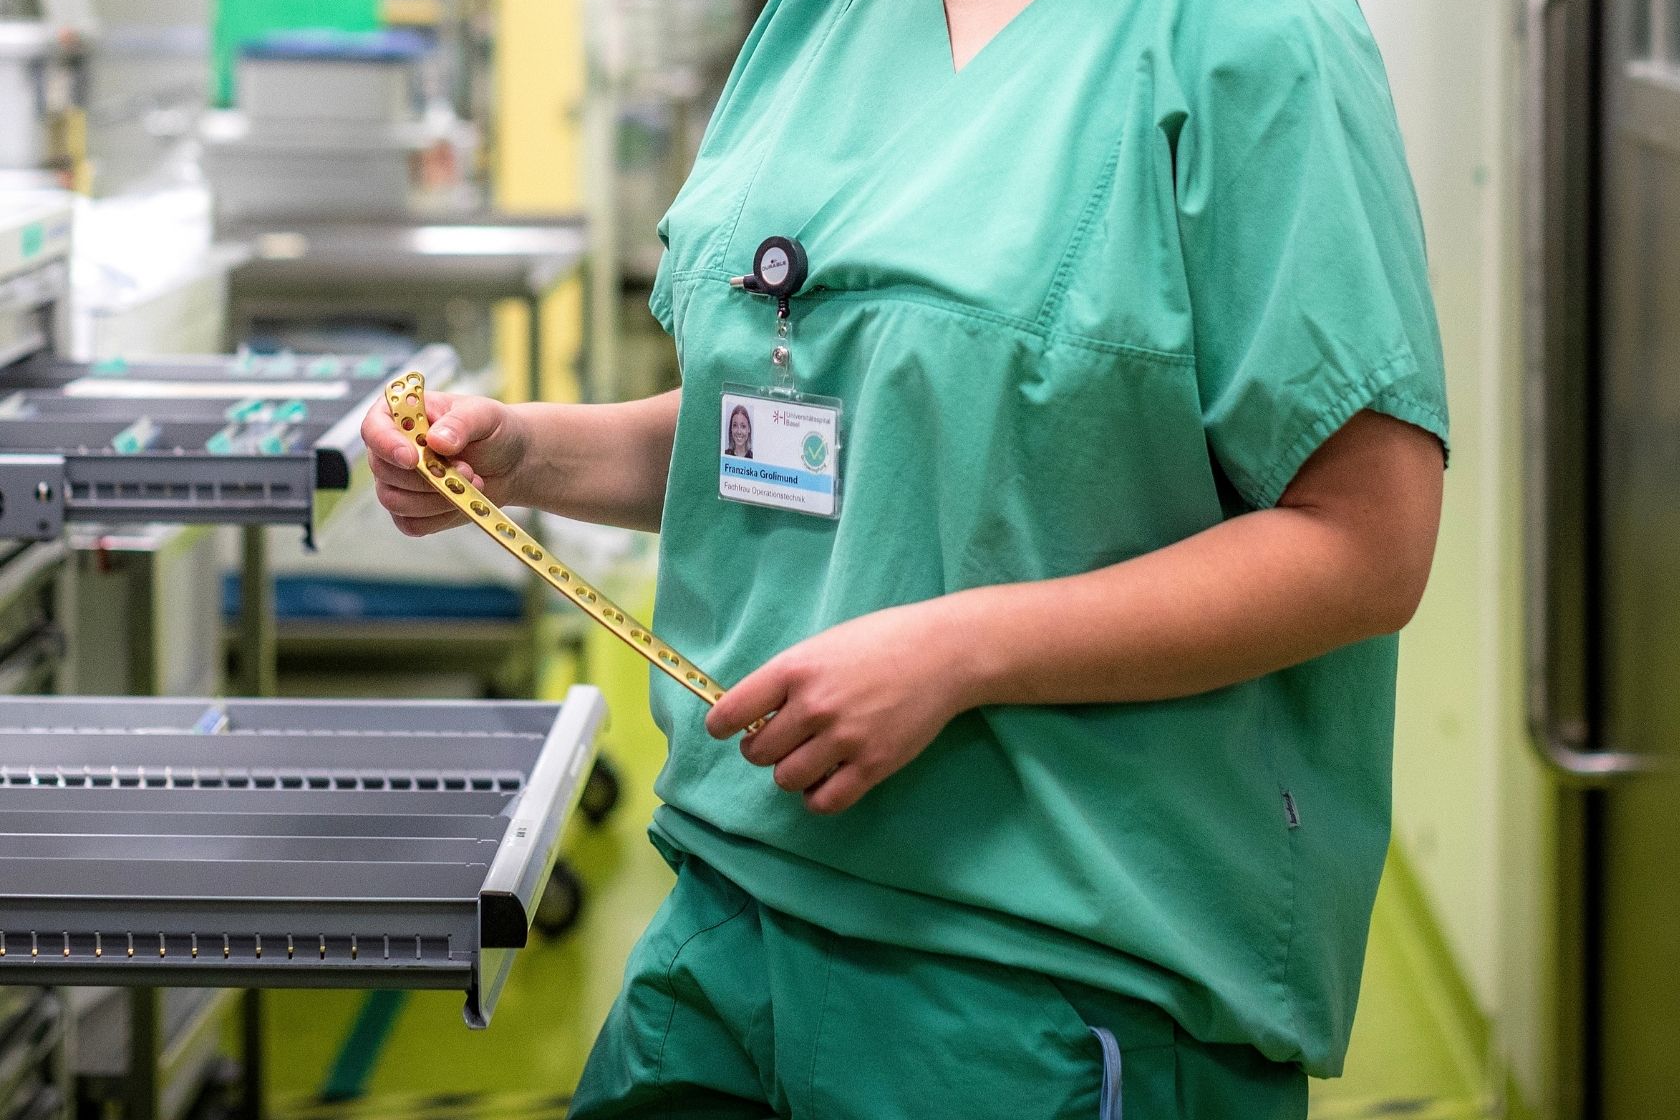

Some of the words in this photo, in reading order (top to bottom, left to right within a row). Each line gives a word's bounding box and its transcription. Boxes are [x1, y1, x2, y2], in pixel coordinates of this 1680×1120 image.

[762, 260, 787, 272] DURABLE
[724, 463, 758, 478] Franziska
[760, 470, 798, 484] Grolimund
[724, 481, 751, 494] Fachfrau
[752, 486, 806, 503] Operationstechnik
